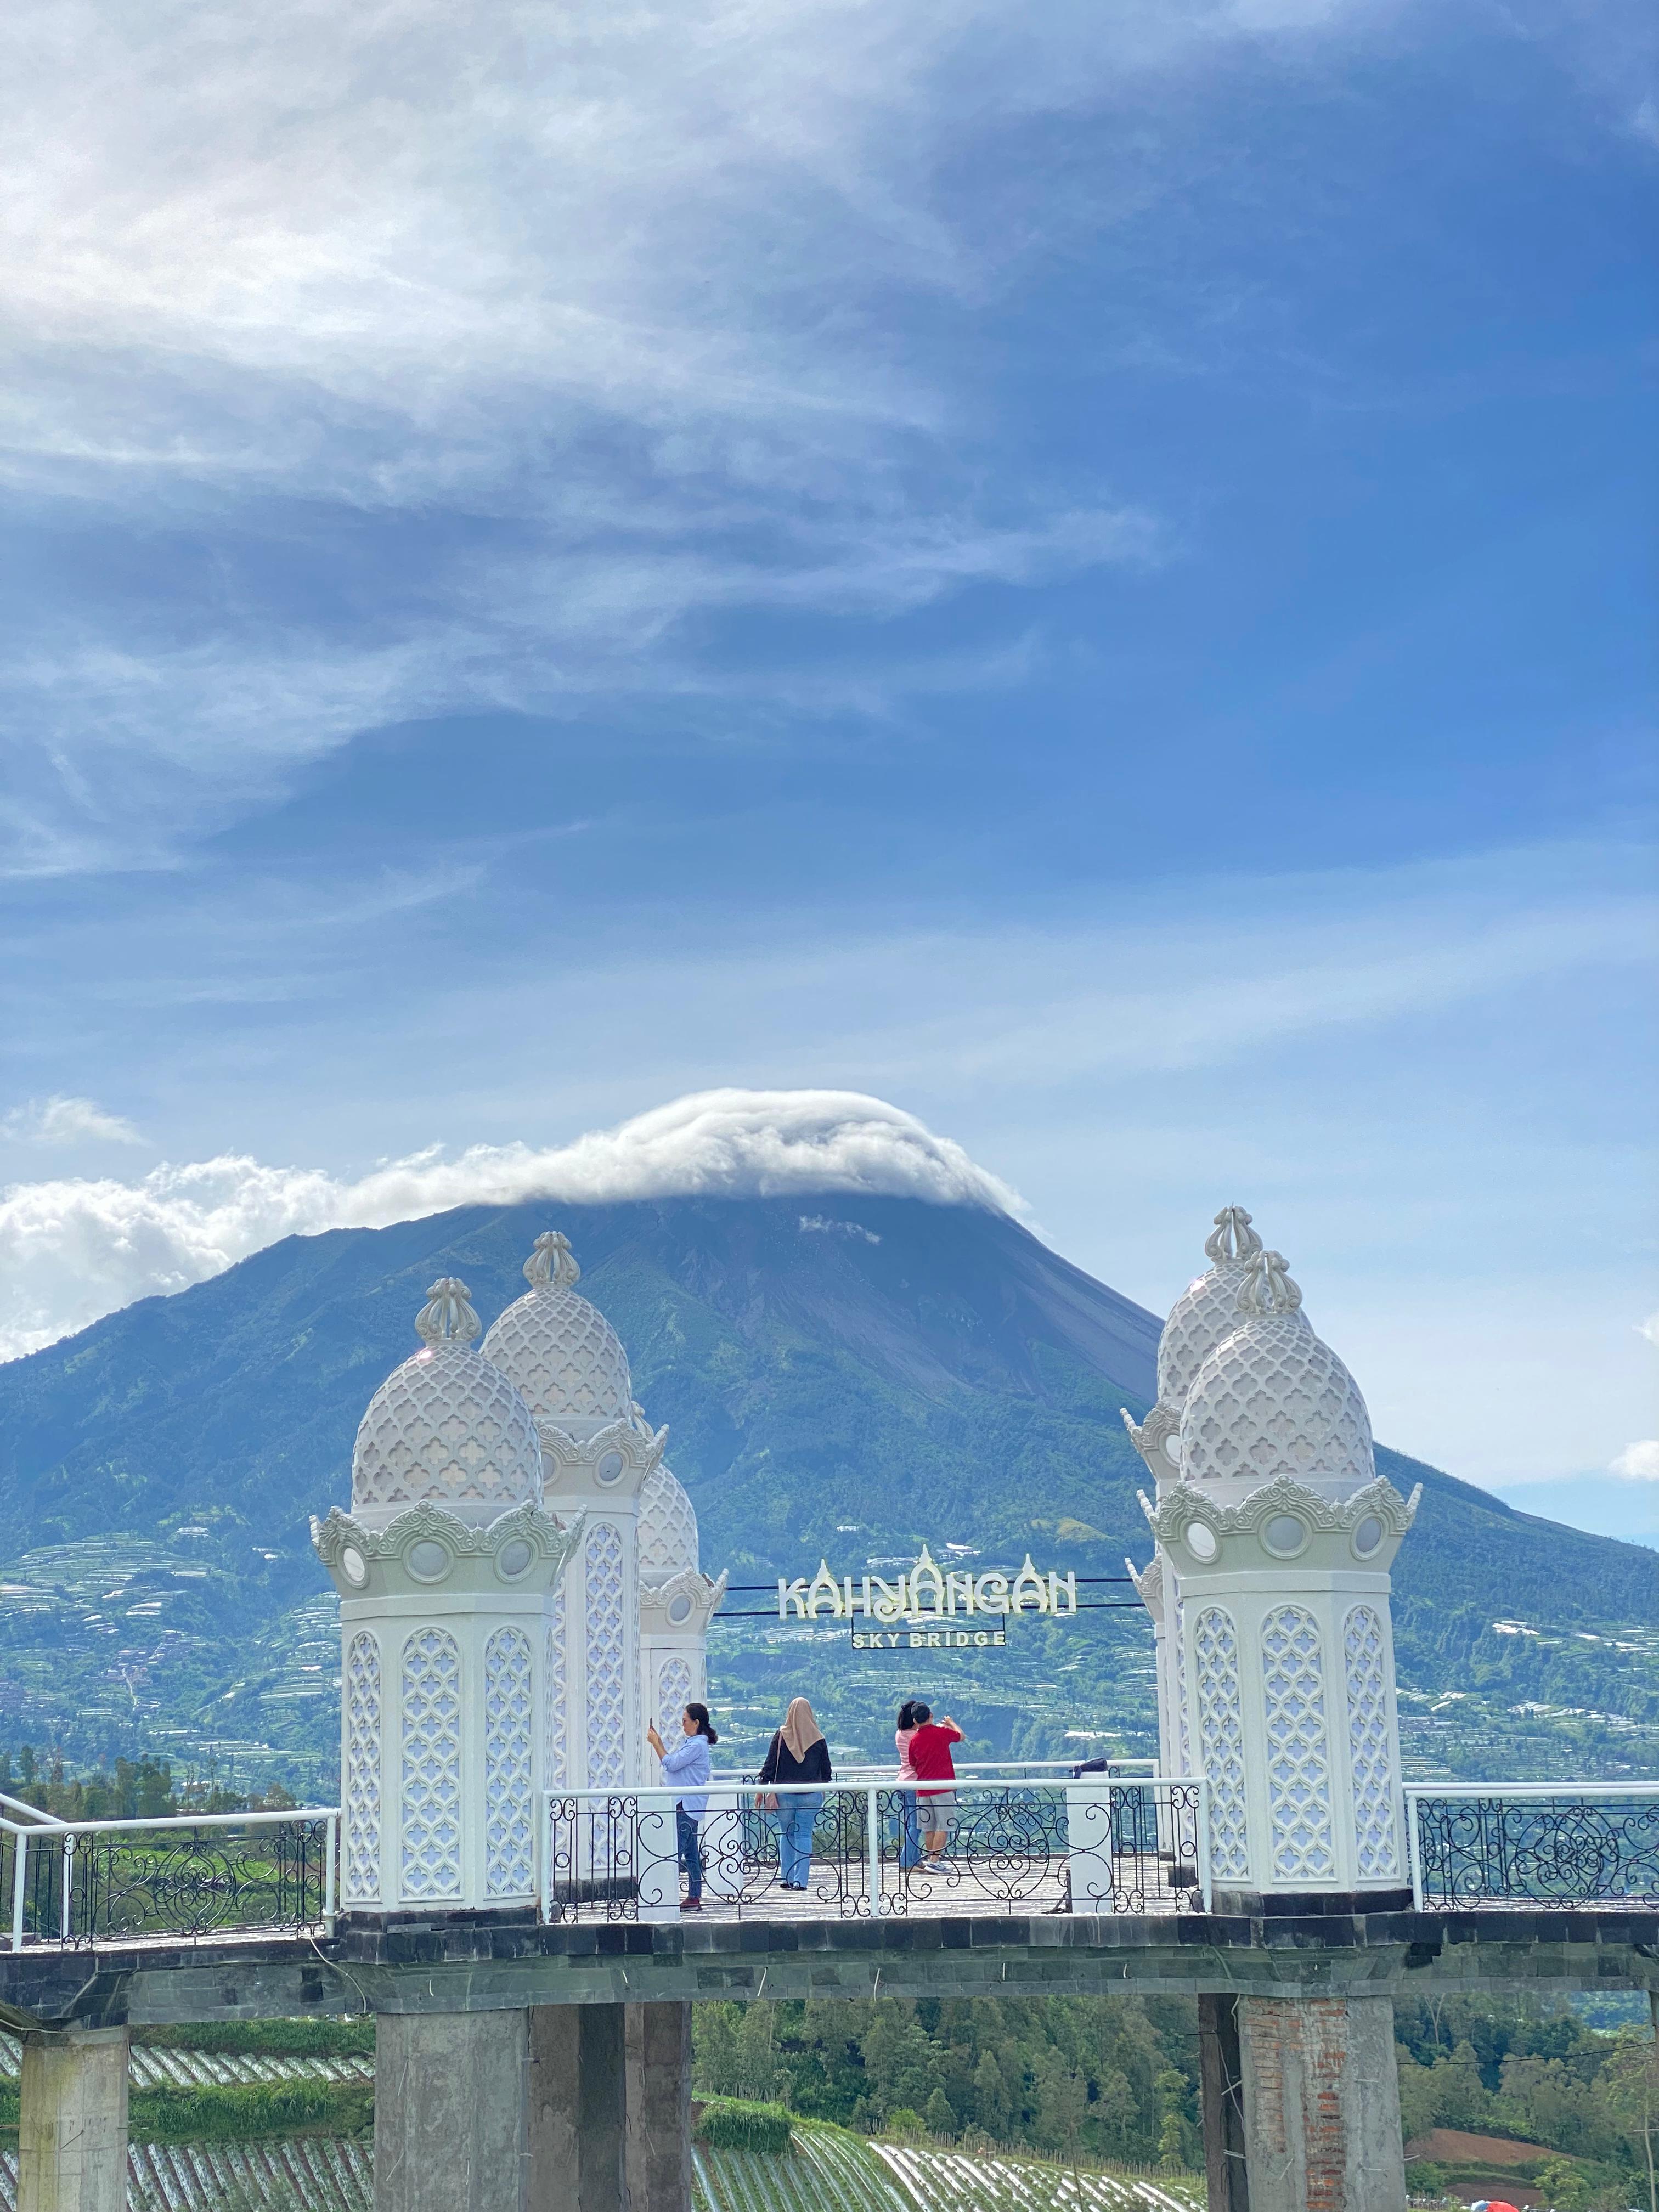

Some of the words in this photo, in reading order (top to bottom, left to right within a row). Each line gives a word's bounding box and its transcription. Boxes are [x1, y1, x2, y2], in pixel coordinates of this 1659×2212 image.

[778, 1544, 1076, 1622] KAHYANGAN
[853, 1633, 900, 1649] SKY
[910, 1631, 1005, 1647] BRIDGE
